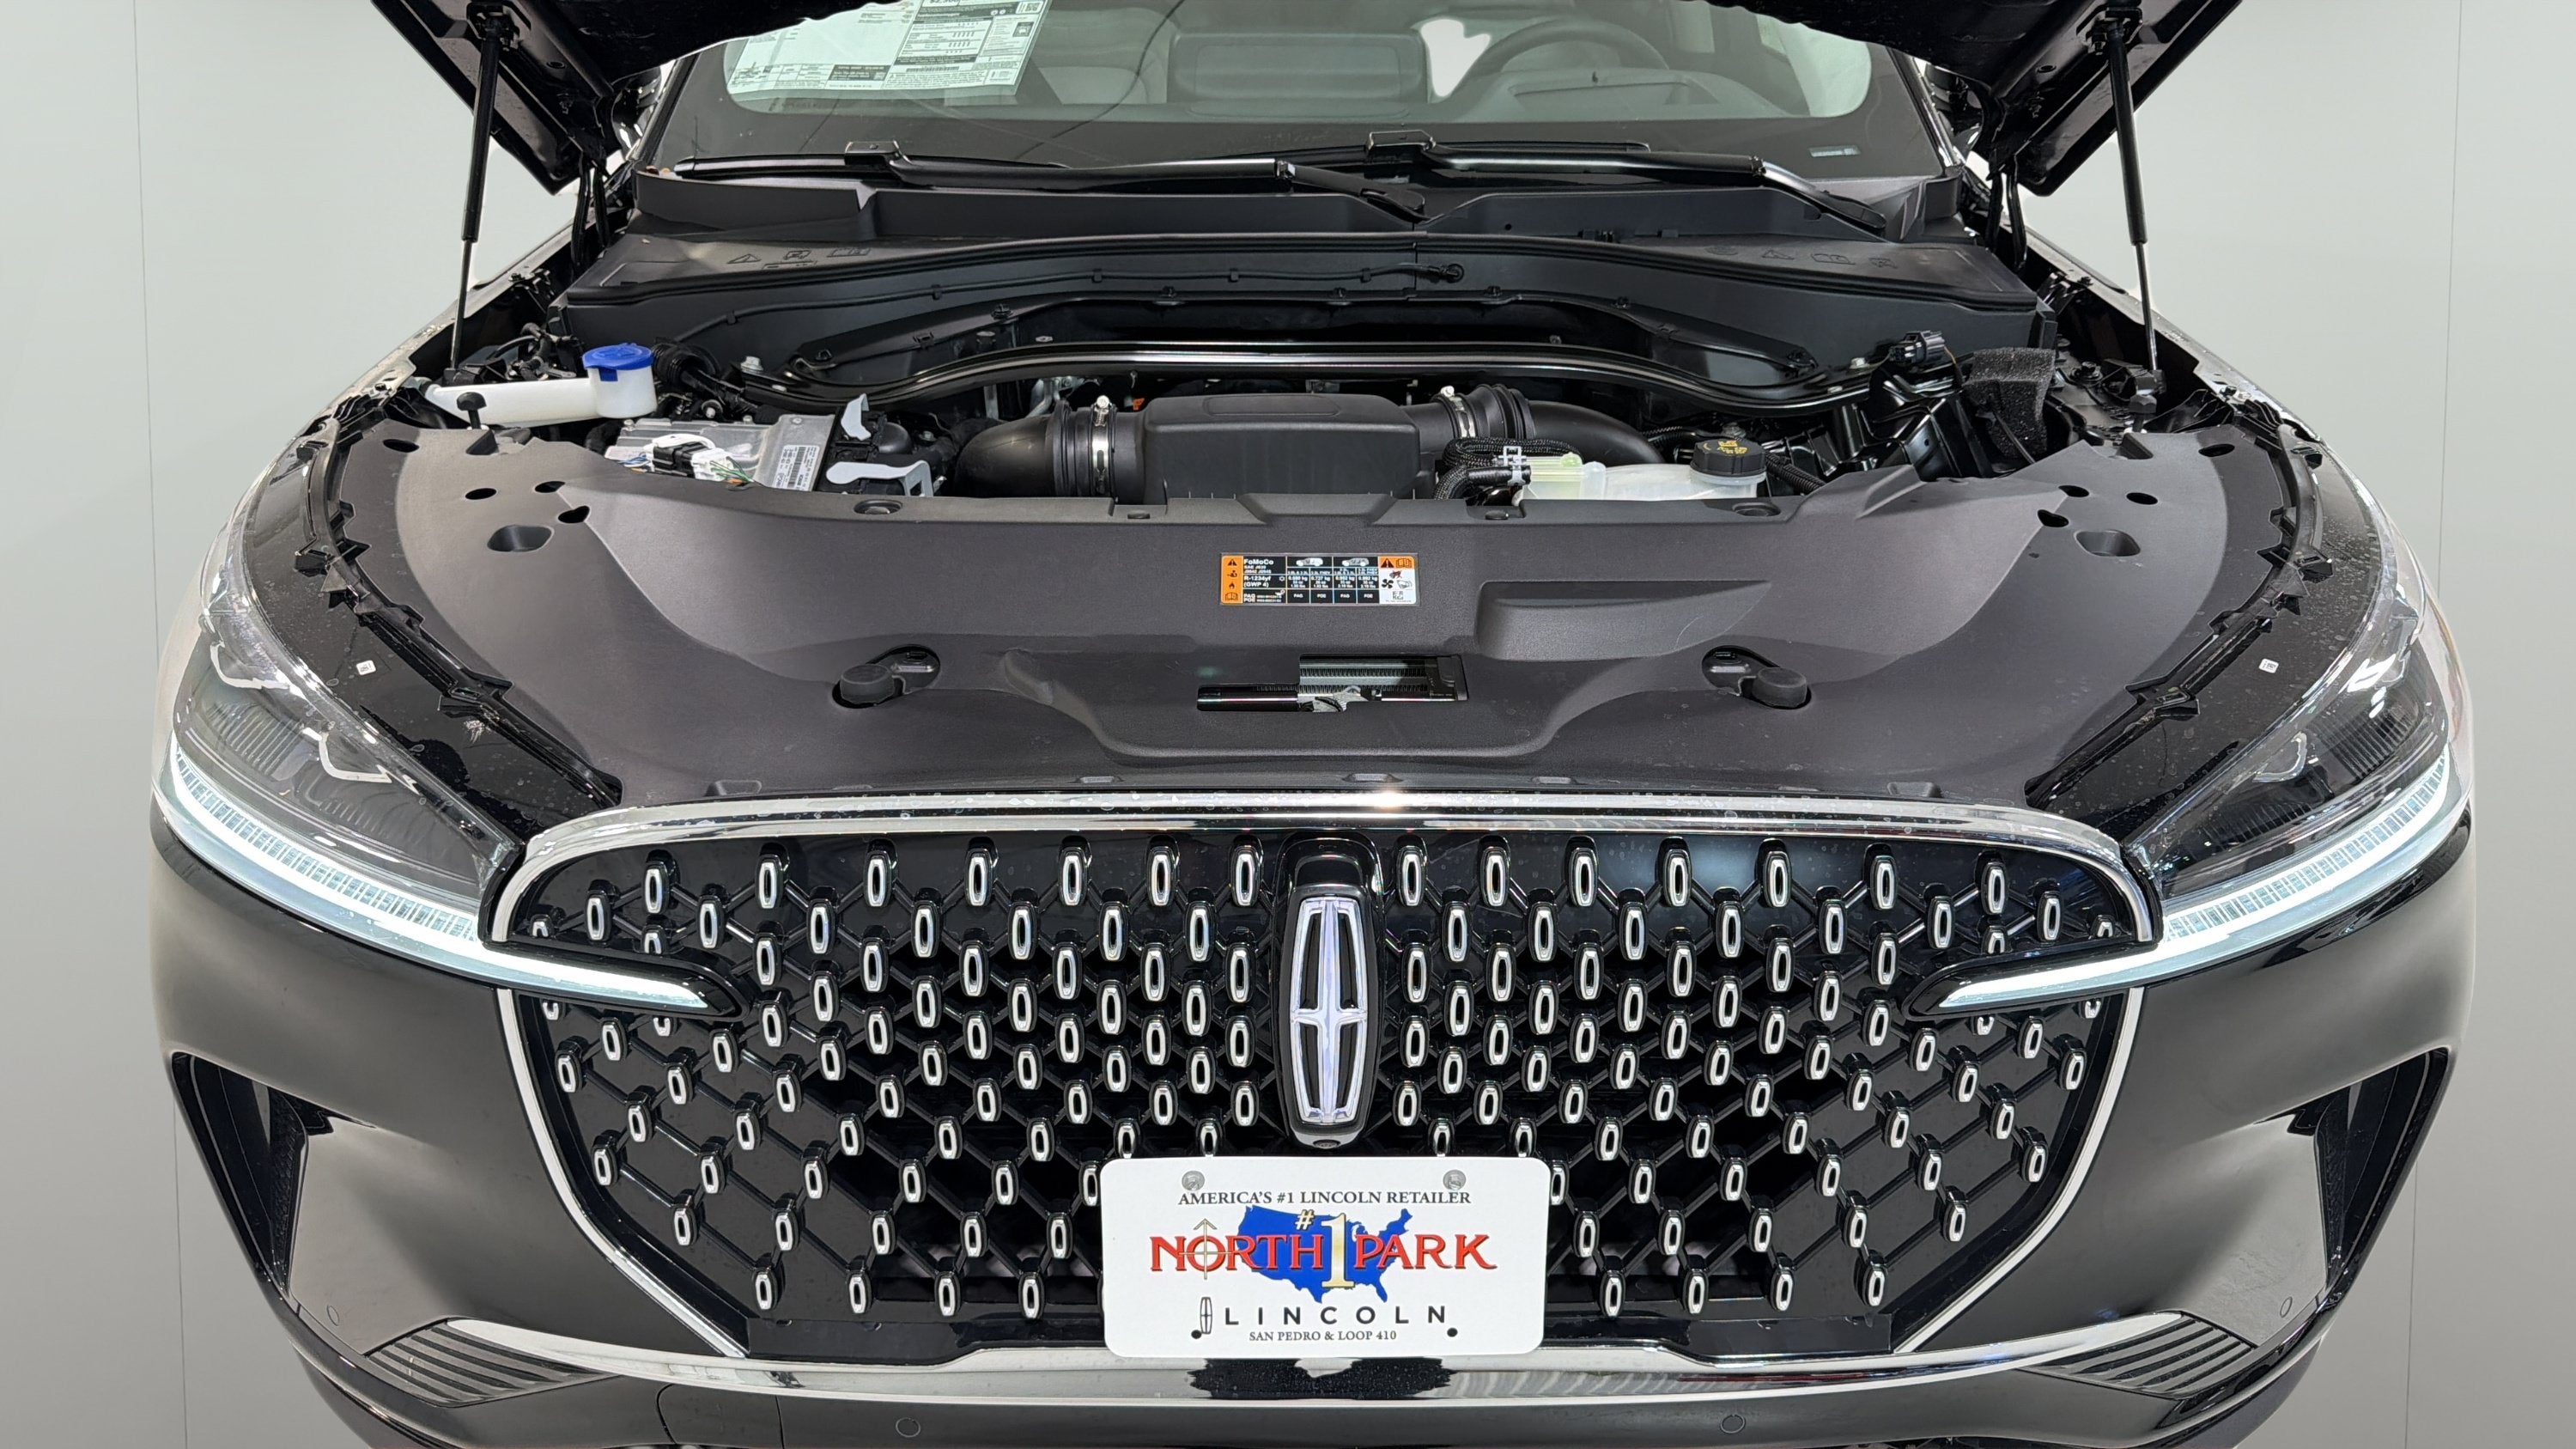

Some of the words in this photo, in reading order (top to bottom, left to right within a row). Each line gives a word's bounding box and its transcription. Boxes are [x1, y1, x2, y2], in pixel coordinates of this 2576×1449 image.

[1277, 1191, 1295, 1204] #1
[1300, 1190, 1382, 1204] LINCOLN
[1387, 1190, 1472, 1204] RETAILER
[1149, 1233, 1324, 1272] NORTH
[1354, 1233, 1499, 1270] PARK
[1225, 1306, 1446, 1325] LINCOLN
[1249, 1331, 1273, 1342] SAN
[1278, 1331, 1321, 1342] PEDRO
[1324, 1331, 1334, 1341] &
[1338, 1330, 1373, 1341] LOOP
[1376, 1330, 1397, 1340] 410
